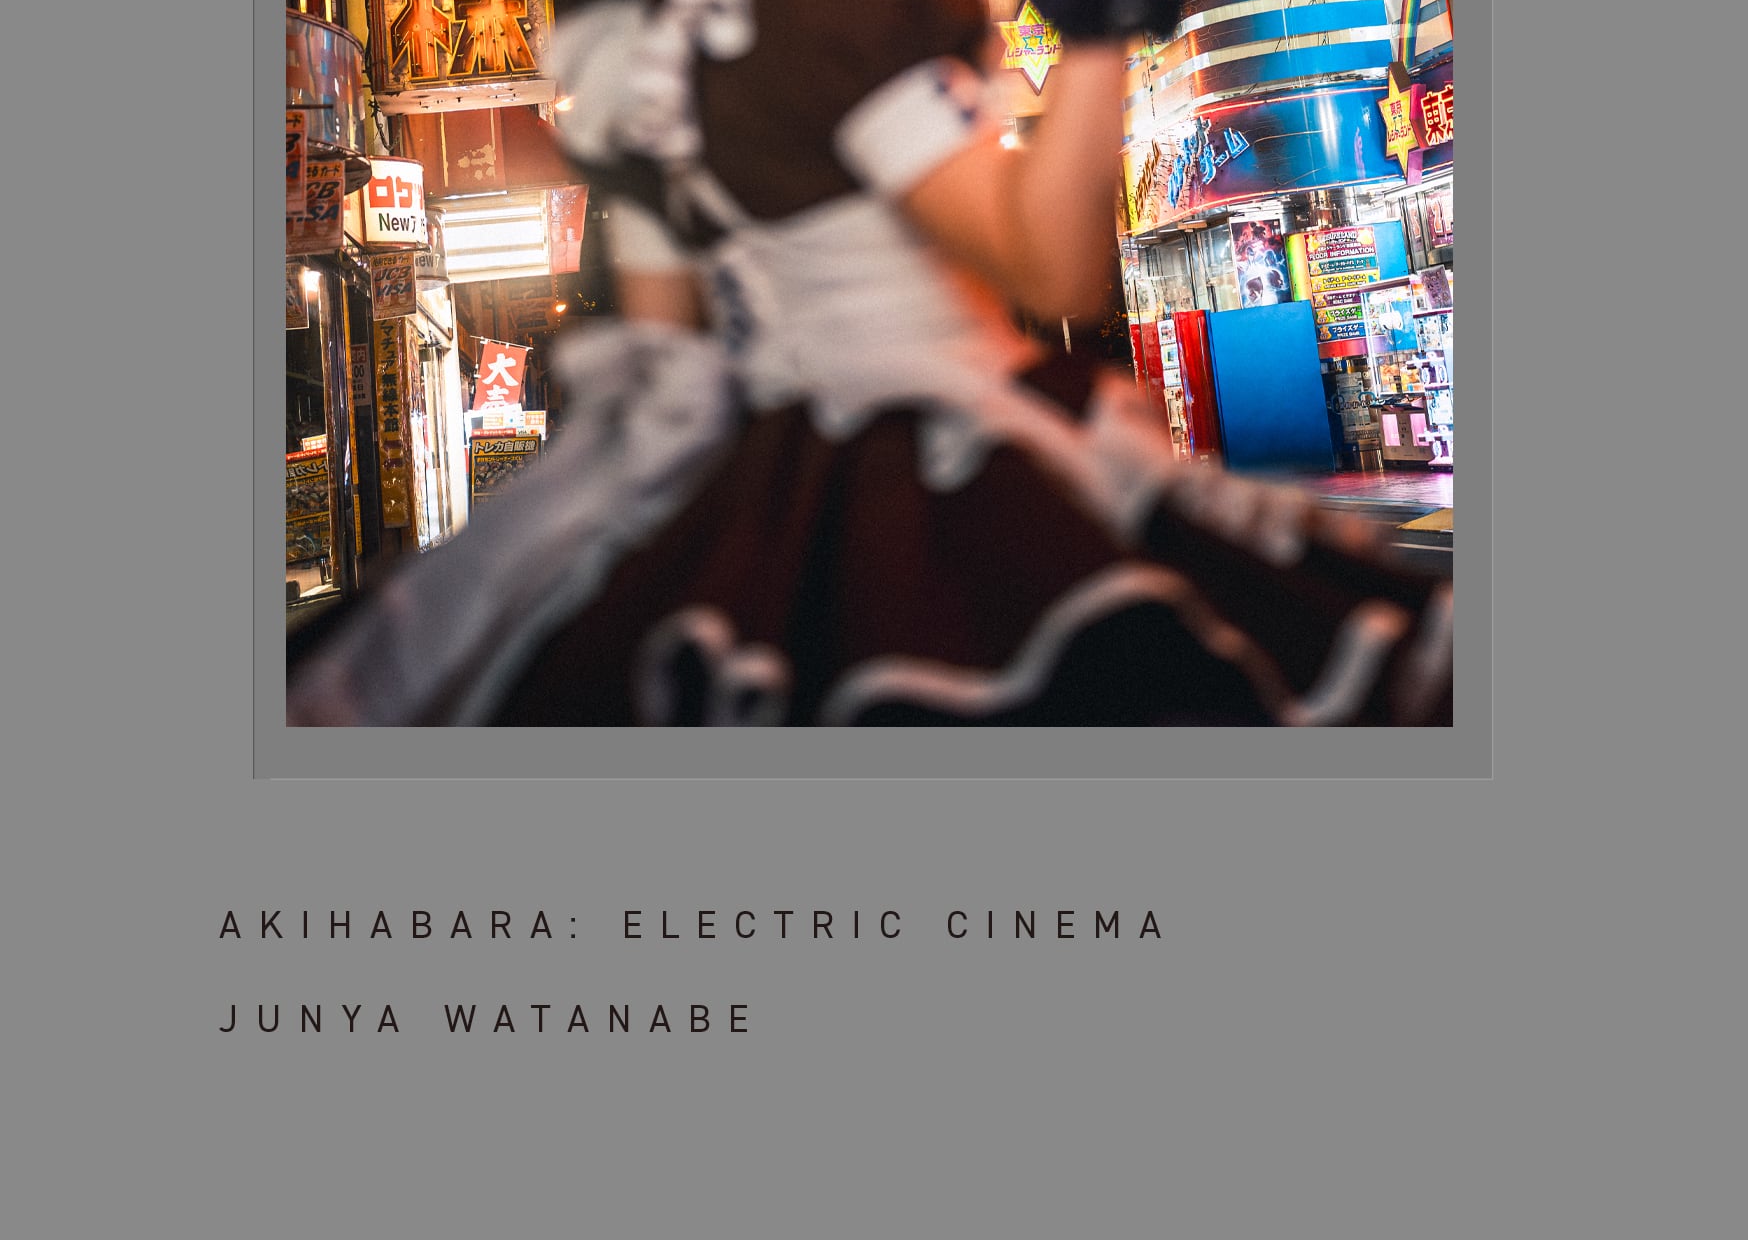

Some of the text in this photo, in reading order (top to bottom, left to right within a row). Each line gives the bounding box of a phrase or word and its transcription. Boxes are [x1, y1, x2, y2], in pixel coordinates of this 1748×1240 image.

[1018, 24, 1045, 37] 東京
[1390, 101, 1402, 116] 東京
[1308, 246, 1374, 261] FLOOR INFORMATION
[374, 265, 412, 282] JCB
[376, 281, 412, 298] VISA
[474, 440, 537, 454] トレカ自販機
